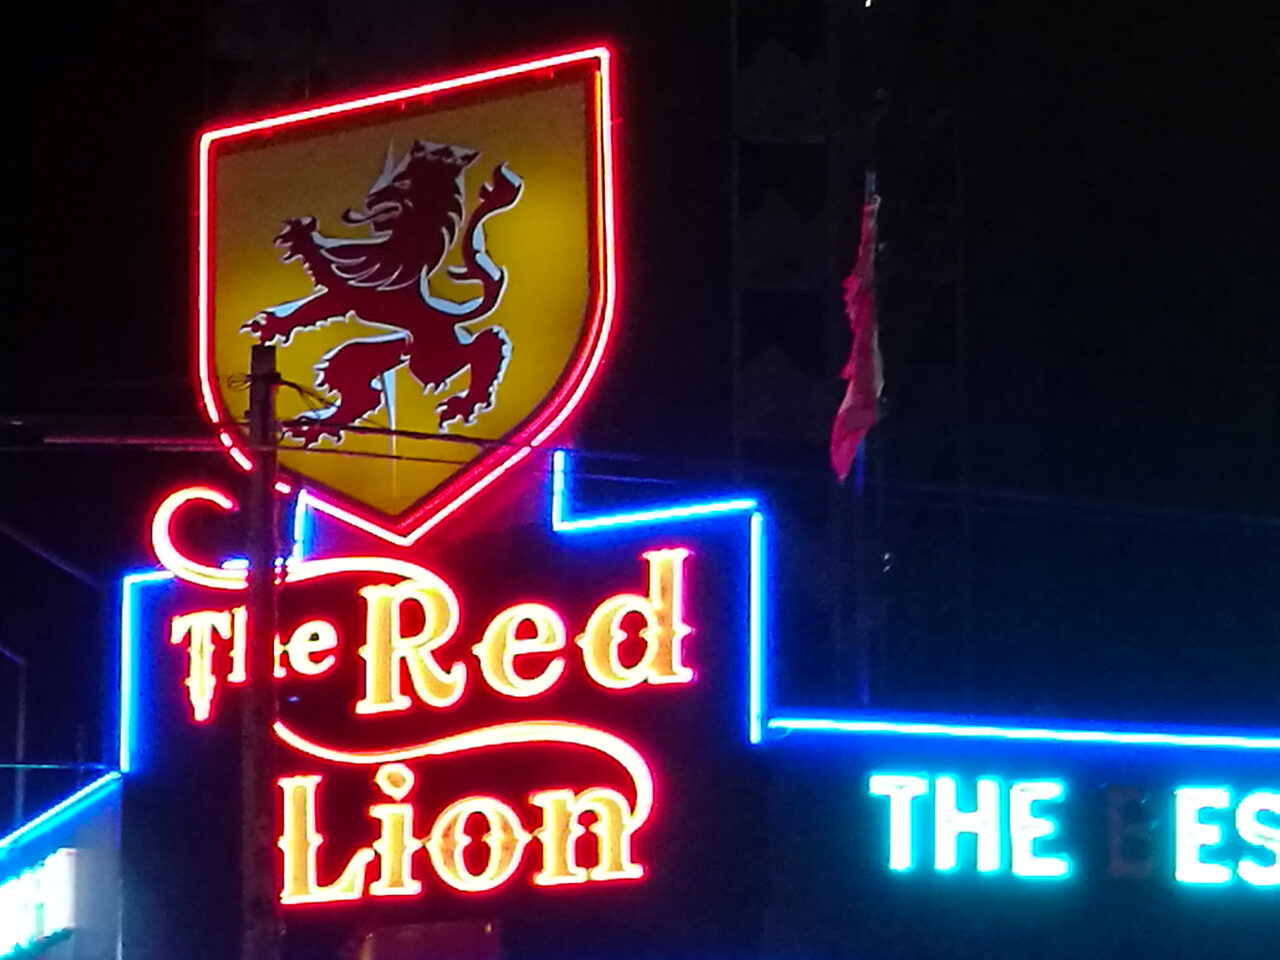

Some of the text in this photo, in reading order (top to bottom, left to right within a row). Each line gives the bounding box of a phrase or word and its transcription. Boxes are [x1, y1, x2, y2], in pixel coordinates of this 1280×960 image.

[355, 548, 694, 715] Red
[278, 763, 646, 904] Lion
[869, 772, 1072, 877] THE
